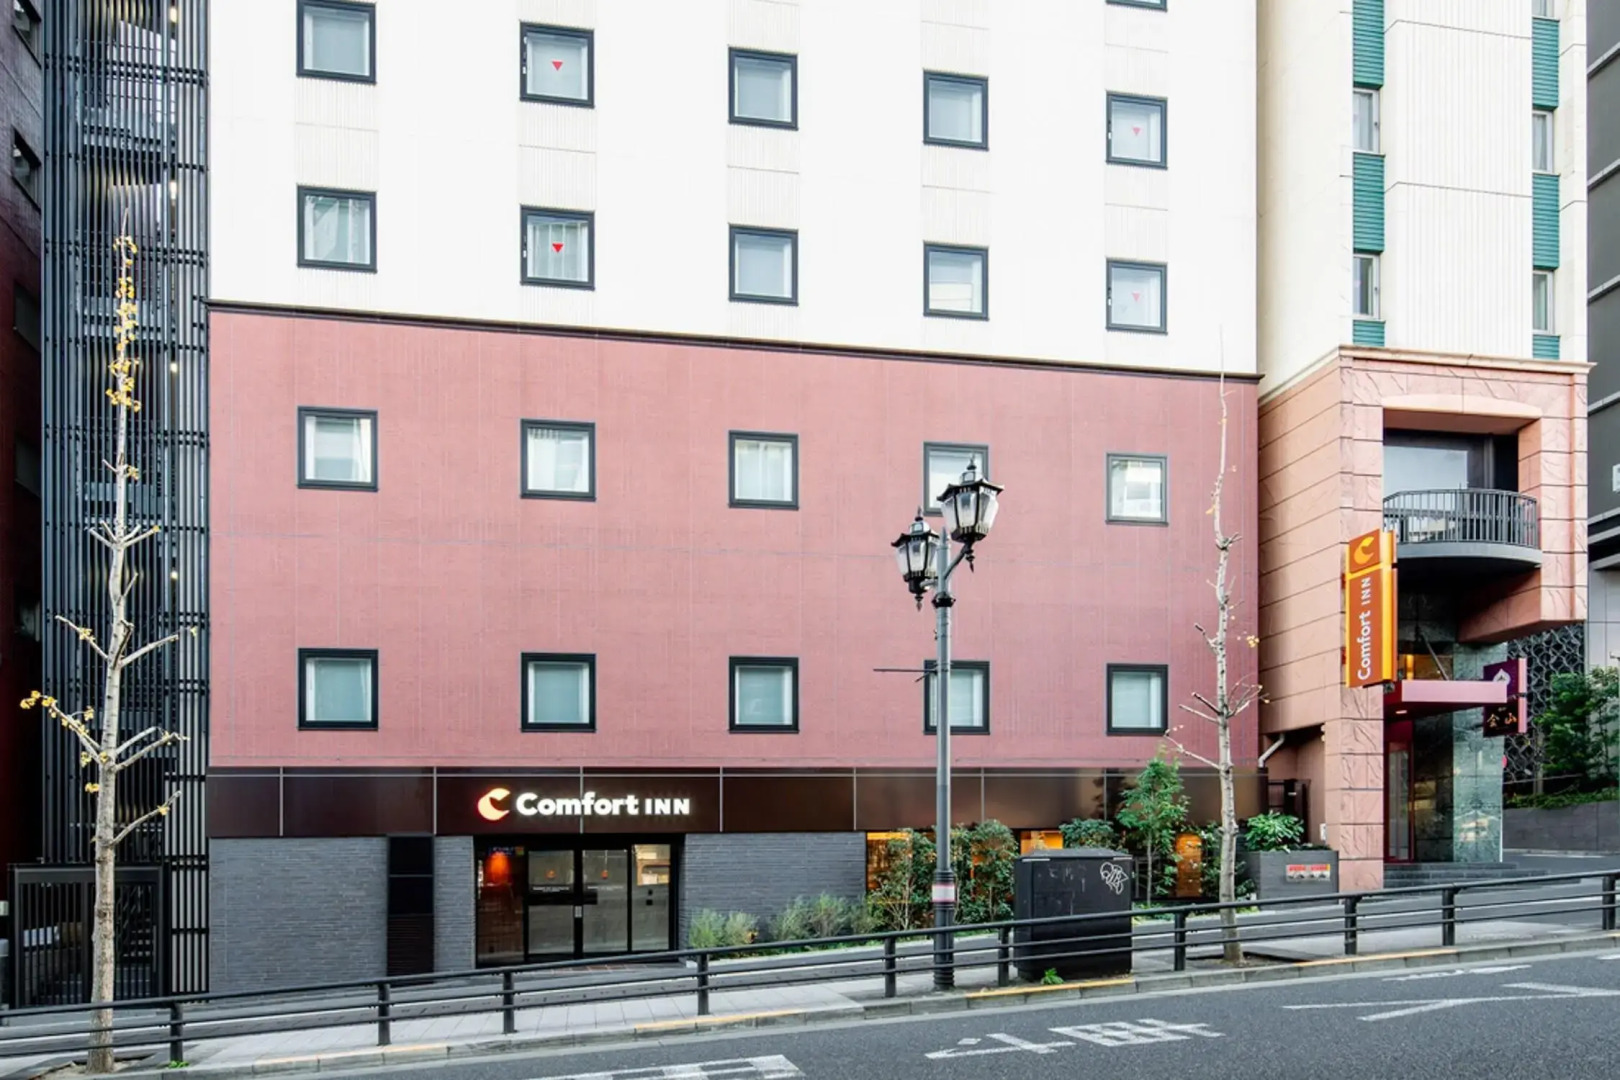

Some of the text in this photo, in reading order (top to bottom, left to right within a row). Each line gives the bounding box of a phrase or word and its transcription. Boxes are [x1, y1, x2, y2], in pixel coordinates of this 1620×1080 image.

[1357, 576, 1371, 680] Comfort INN
[515, 791, 690, 816] Comfort INN
